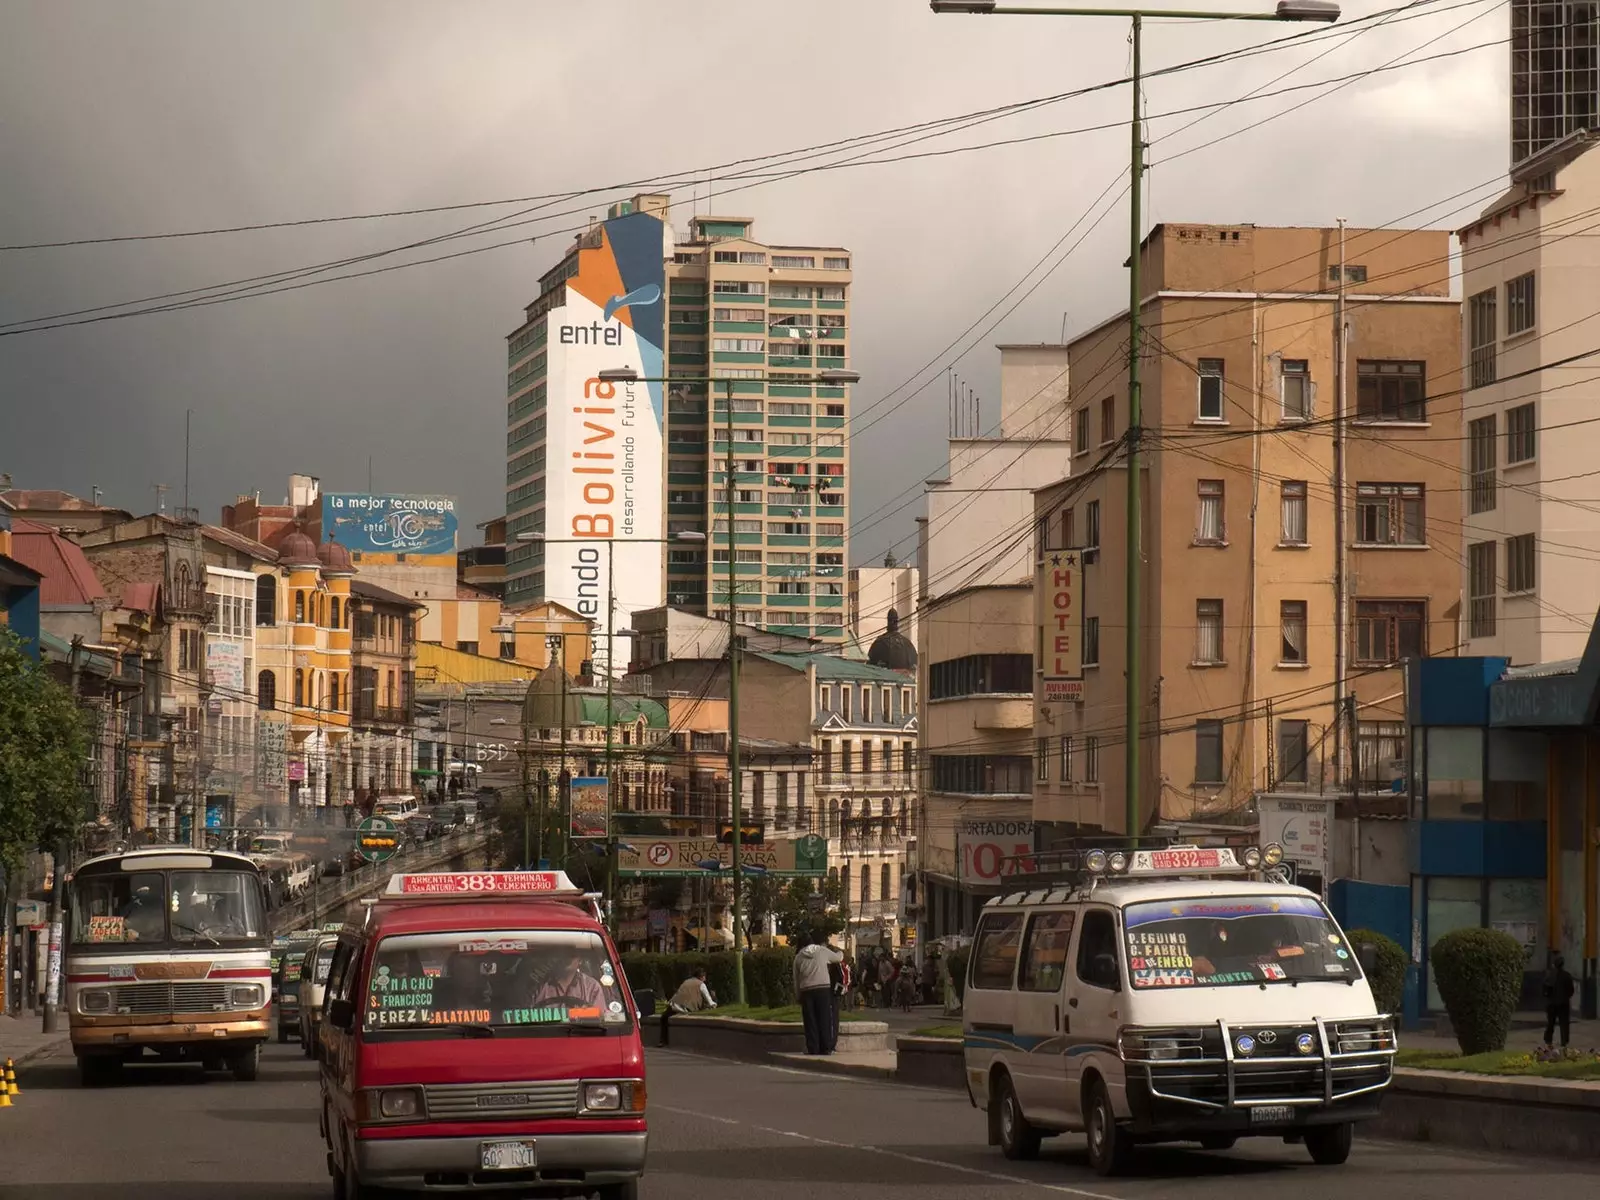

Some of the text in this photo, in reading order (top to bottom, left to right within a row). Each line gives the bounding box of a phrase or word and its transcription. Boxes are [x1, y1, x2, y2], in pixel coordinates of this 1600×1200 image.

[560, 321, 621, 346] entel
[572, 377, 615, 538] Bolivia
[620, 437, 635, 534] desarrollando
[331, 496, 344, 508] la
[348, 496, 386, 511] mejor
[1053, 569, 1072, 675] HOTEL
[678, 841, 698, 851] EN
[678, 852, 703, 863] NO
[1171, 851, 1200, 867] 332
[456, 875, 496, 891] 383
[503, 874, 547, 882] TERMINAL
[497, 881, 551, 890] CEMENTERIO
[1156, 955, 1194, 969] ENERO
[382, 993, 433, 1007] FRANCISCO
[368, 1010, 417, 1024] PEREZ
